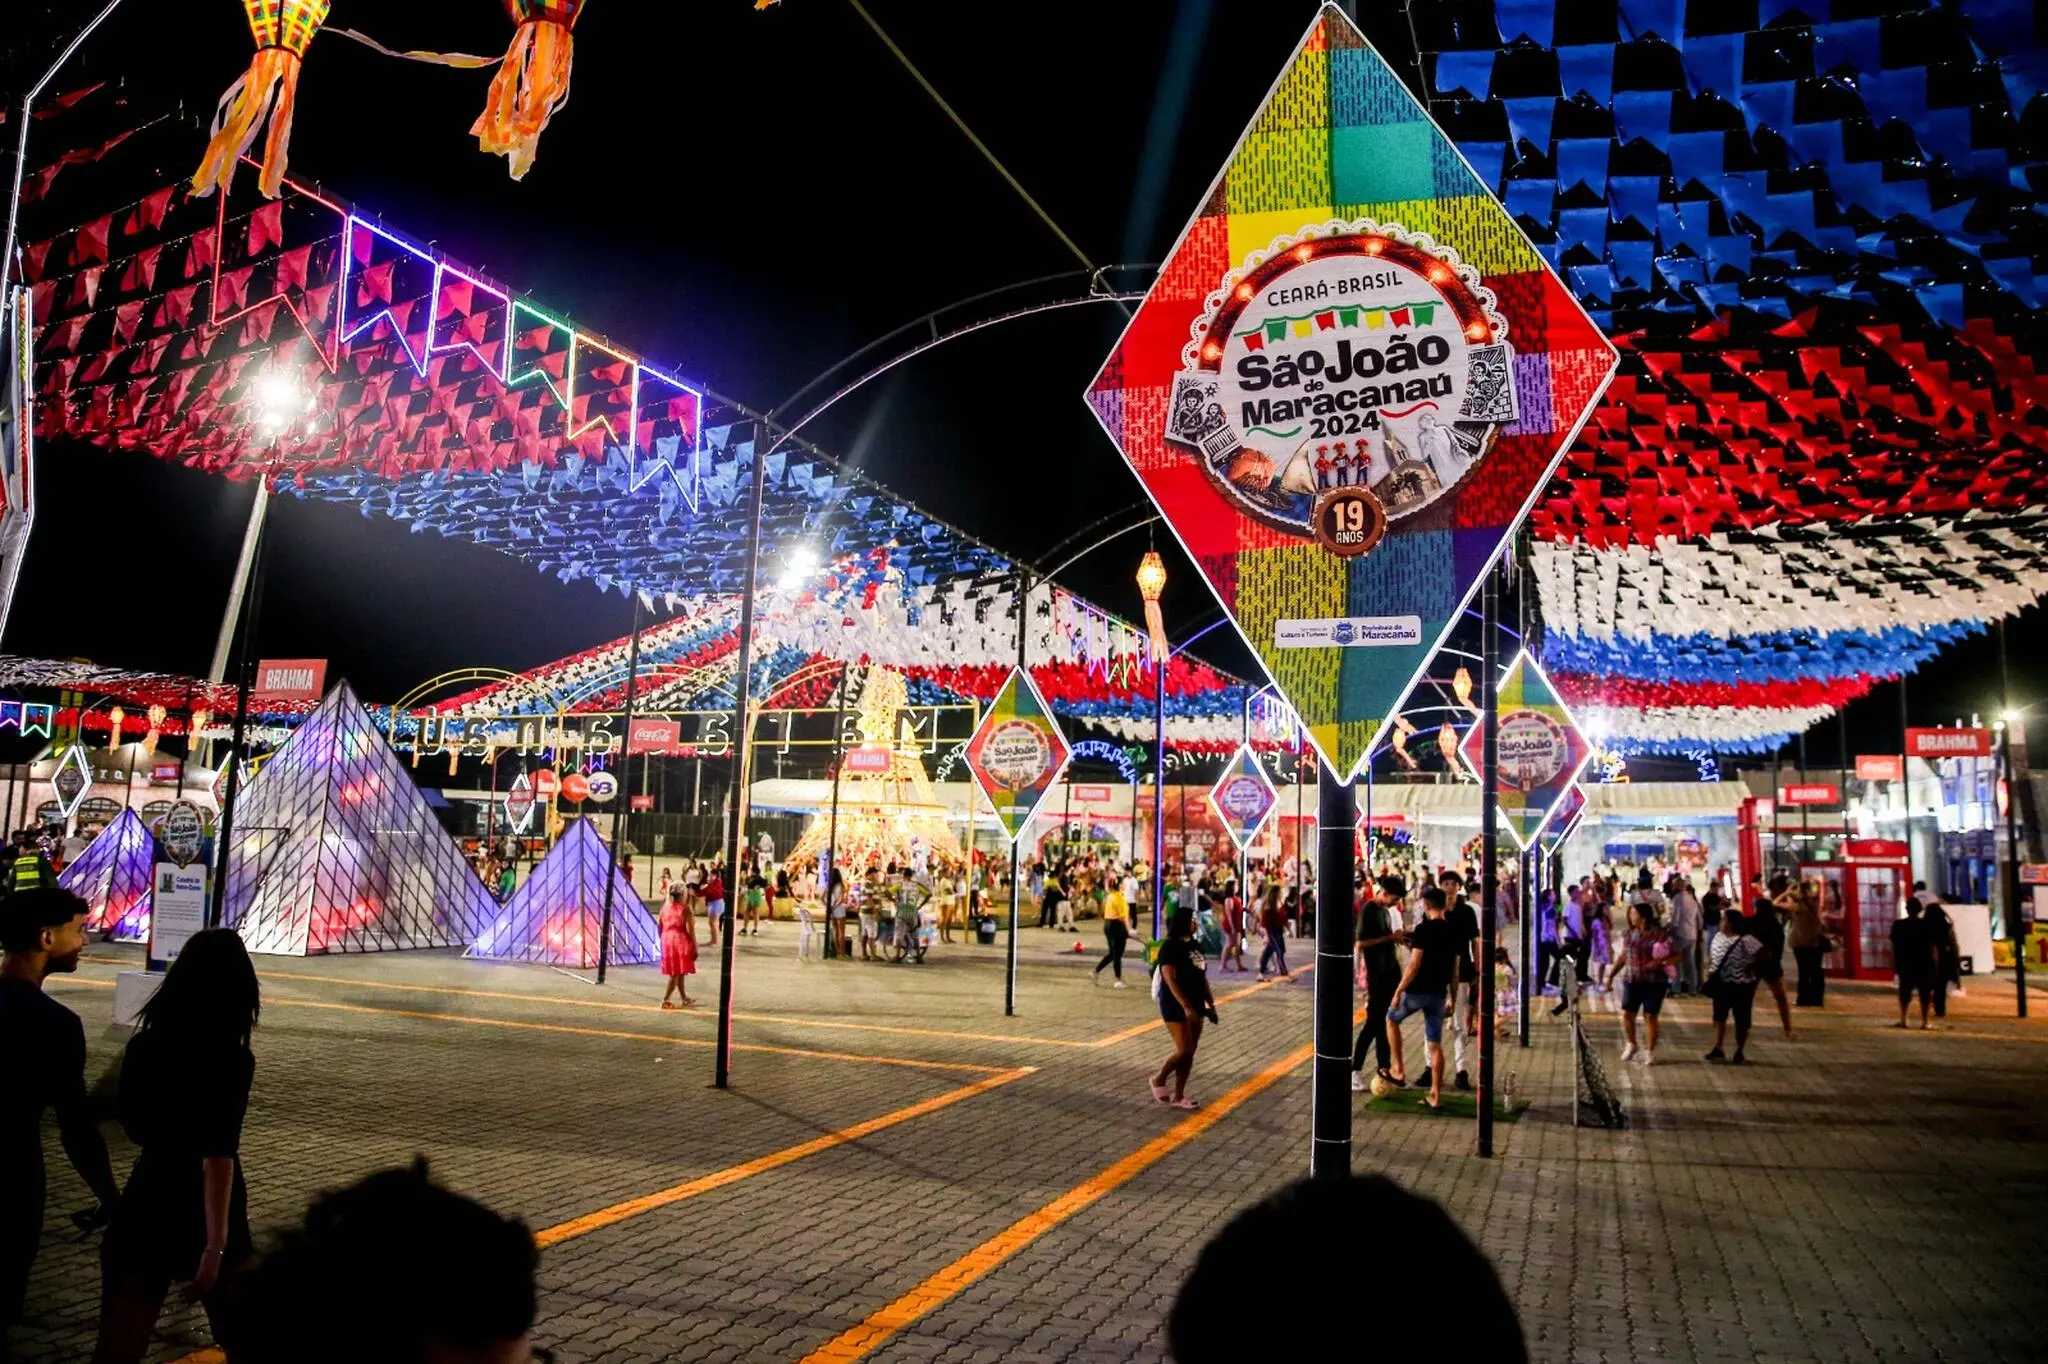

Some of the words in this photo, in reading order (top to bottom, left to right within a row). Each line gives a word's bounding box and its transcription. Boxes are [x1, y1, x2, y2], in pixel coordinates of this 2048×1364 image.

[1267, 270, 1403, 306] CEARÁ-BRASIL
[1237, 349, 1326, 391] São
[1325, 333, 1451, 384] João
[1304, 378, 1324, 393] de
[1242, 370, 1453, 428] Maracanaú
[1310, 409, 1381, 440] 2024
[1333, 500, 1364, 531] 19
[1336, 529, 1364, 544] ANOS
[1361, 629, 1416, 639] Maracanaú
[265, 667, 314, 691] BRAHMA
[634, 727, 672, 742] Coca-Cola
[1916, 735, 1978, 752] BRAHMA
[590, 781, 613, 795] 93
